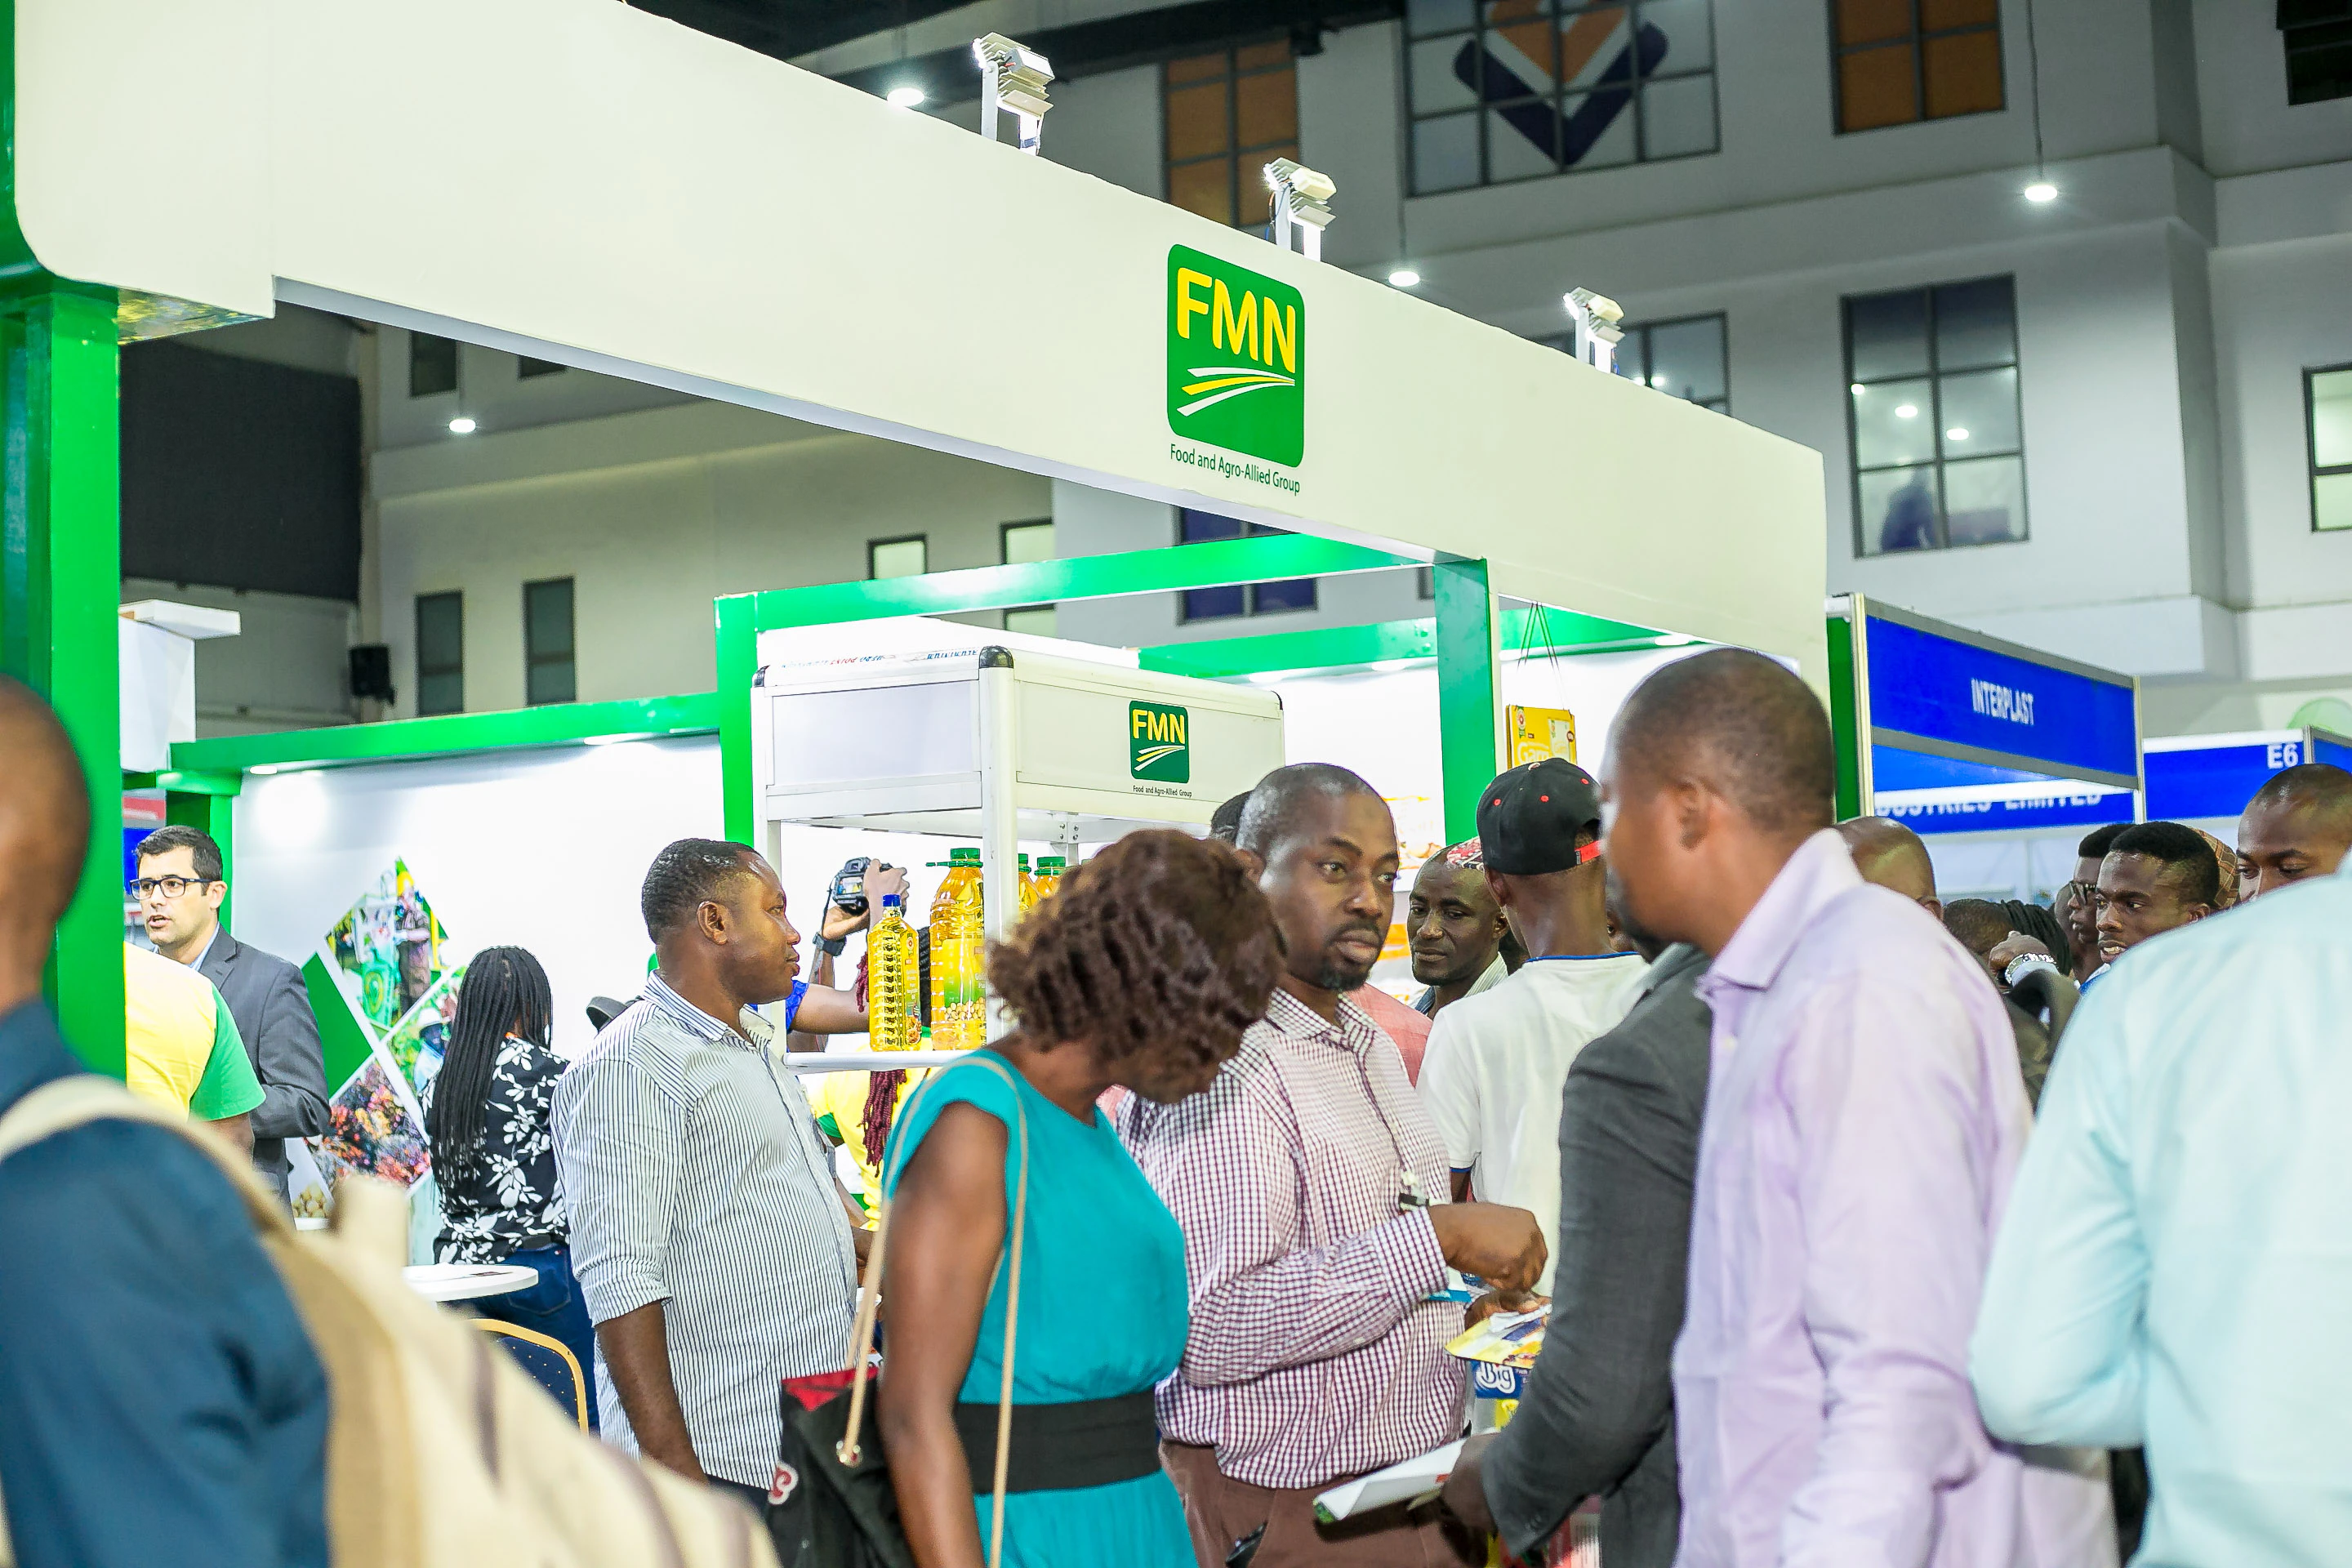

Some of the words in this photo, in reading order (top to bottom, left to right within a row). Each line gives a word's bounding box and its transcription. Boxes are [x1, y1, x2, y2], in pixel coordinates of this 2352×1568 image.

[1177, 267, 1296, 374] FMN
[1170, 443, 1196, 466] Food
[1197, 453, 1216, 471] and
[1218, 456, 1271, 486] Agro-Allied
[1272, 470, 1300, 497] Group
[1971, 677, 2034, 726] INTERPLAST
[1132, 708, 1186, 745] FMN
[2267, 743, 2298, 769] E6
[1133, 785, 1144, 793] Food
[1145, 786, 1154, 794] and
[1154, 786, 1178, 796] Agro-Allied
[1178, 789, 1192, 798] Group
[1476, 1361, 1517, 1394] Big
